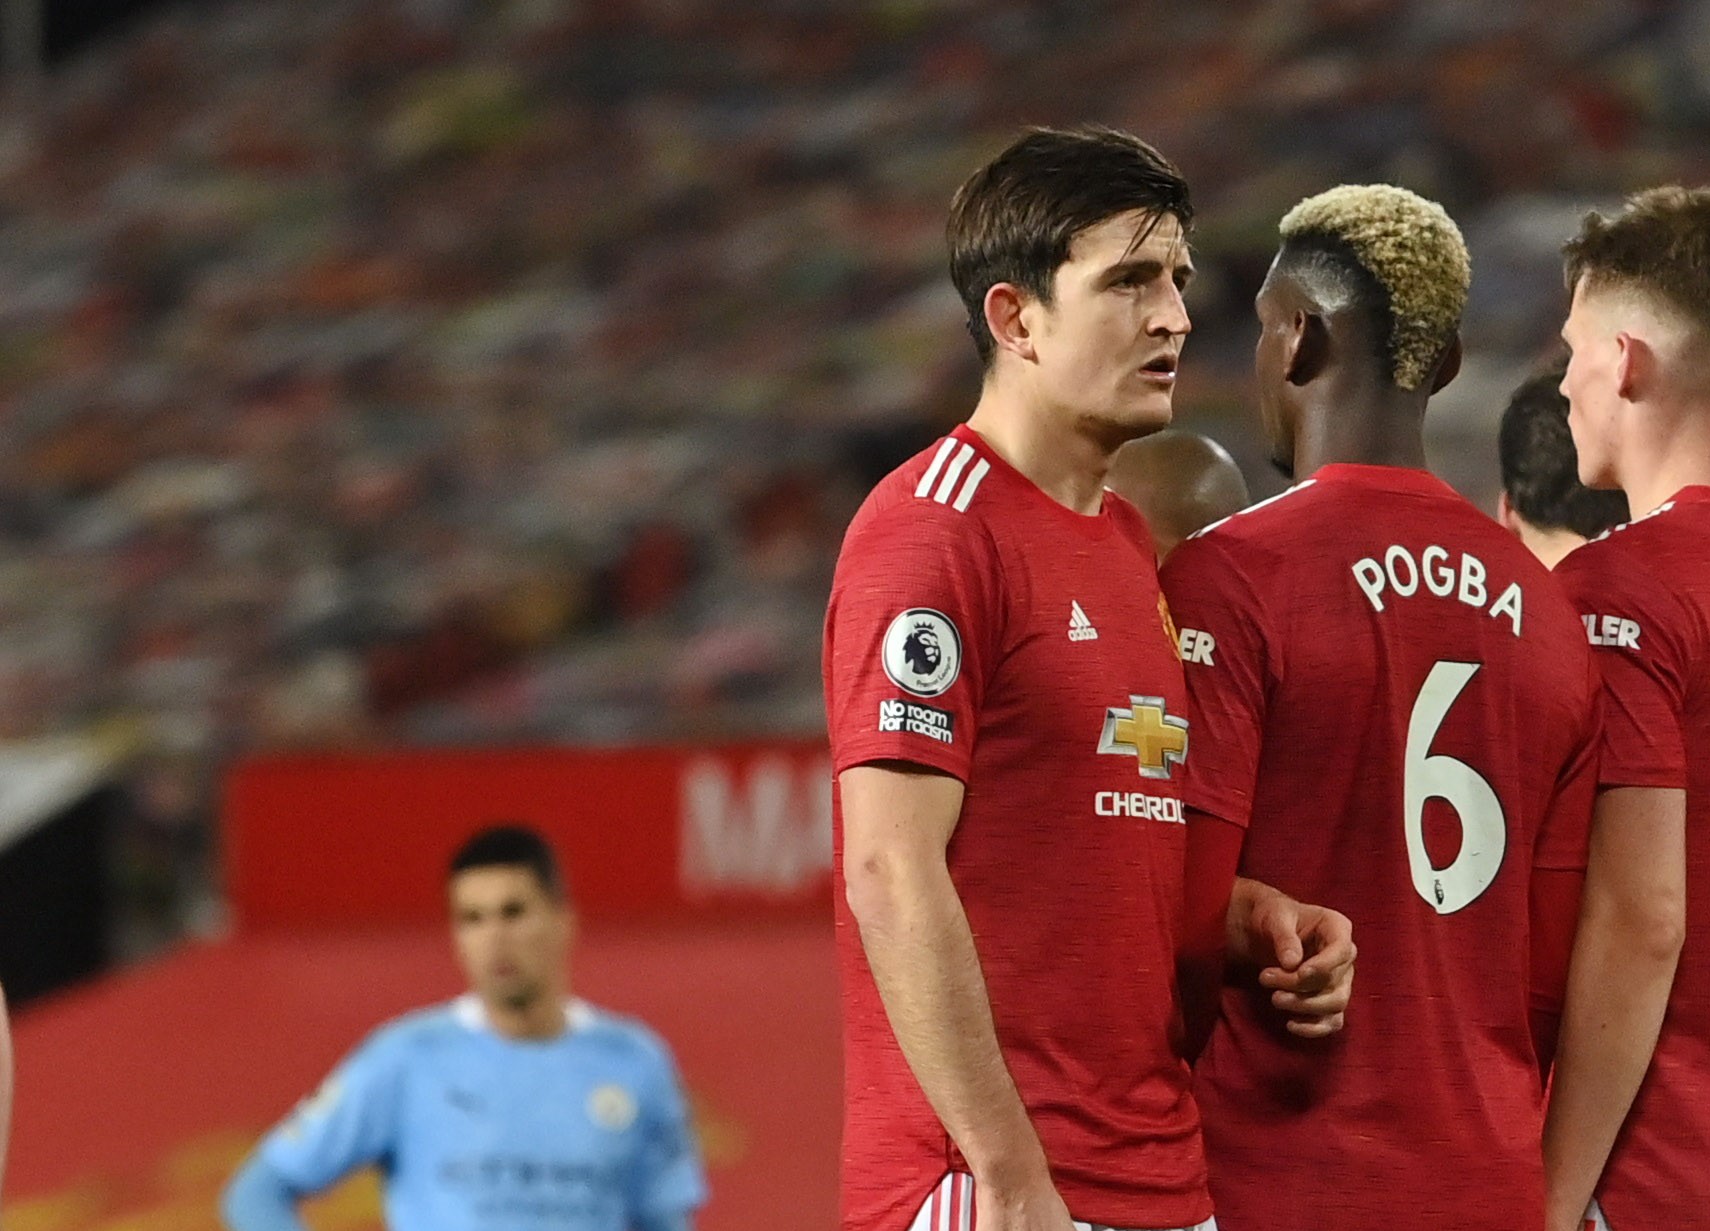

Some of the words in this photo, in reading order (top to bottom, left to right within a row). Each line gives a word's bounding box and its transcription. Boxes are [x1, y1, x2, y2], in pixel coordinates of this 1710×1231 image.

[1351, 544, 1523, 638] POGBA
[879, 699, 905, 718] No
[907, 704, 948, 728] room
[906, 717, 953, 744] racism
[1403, 660, 1507, 916] 6
